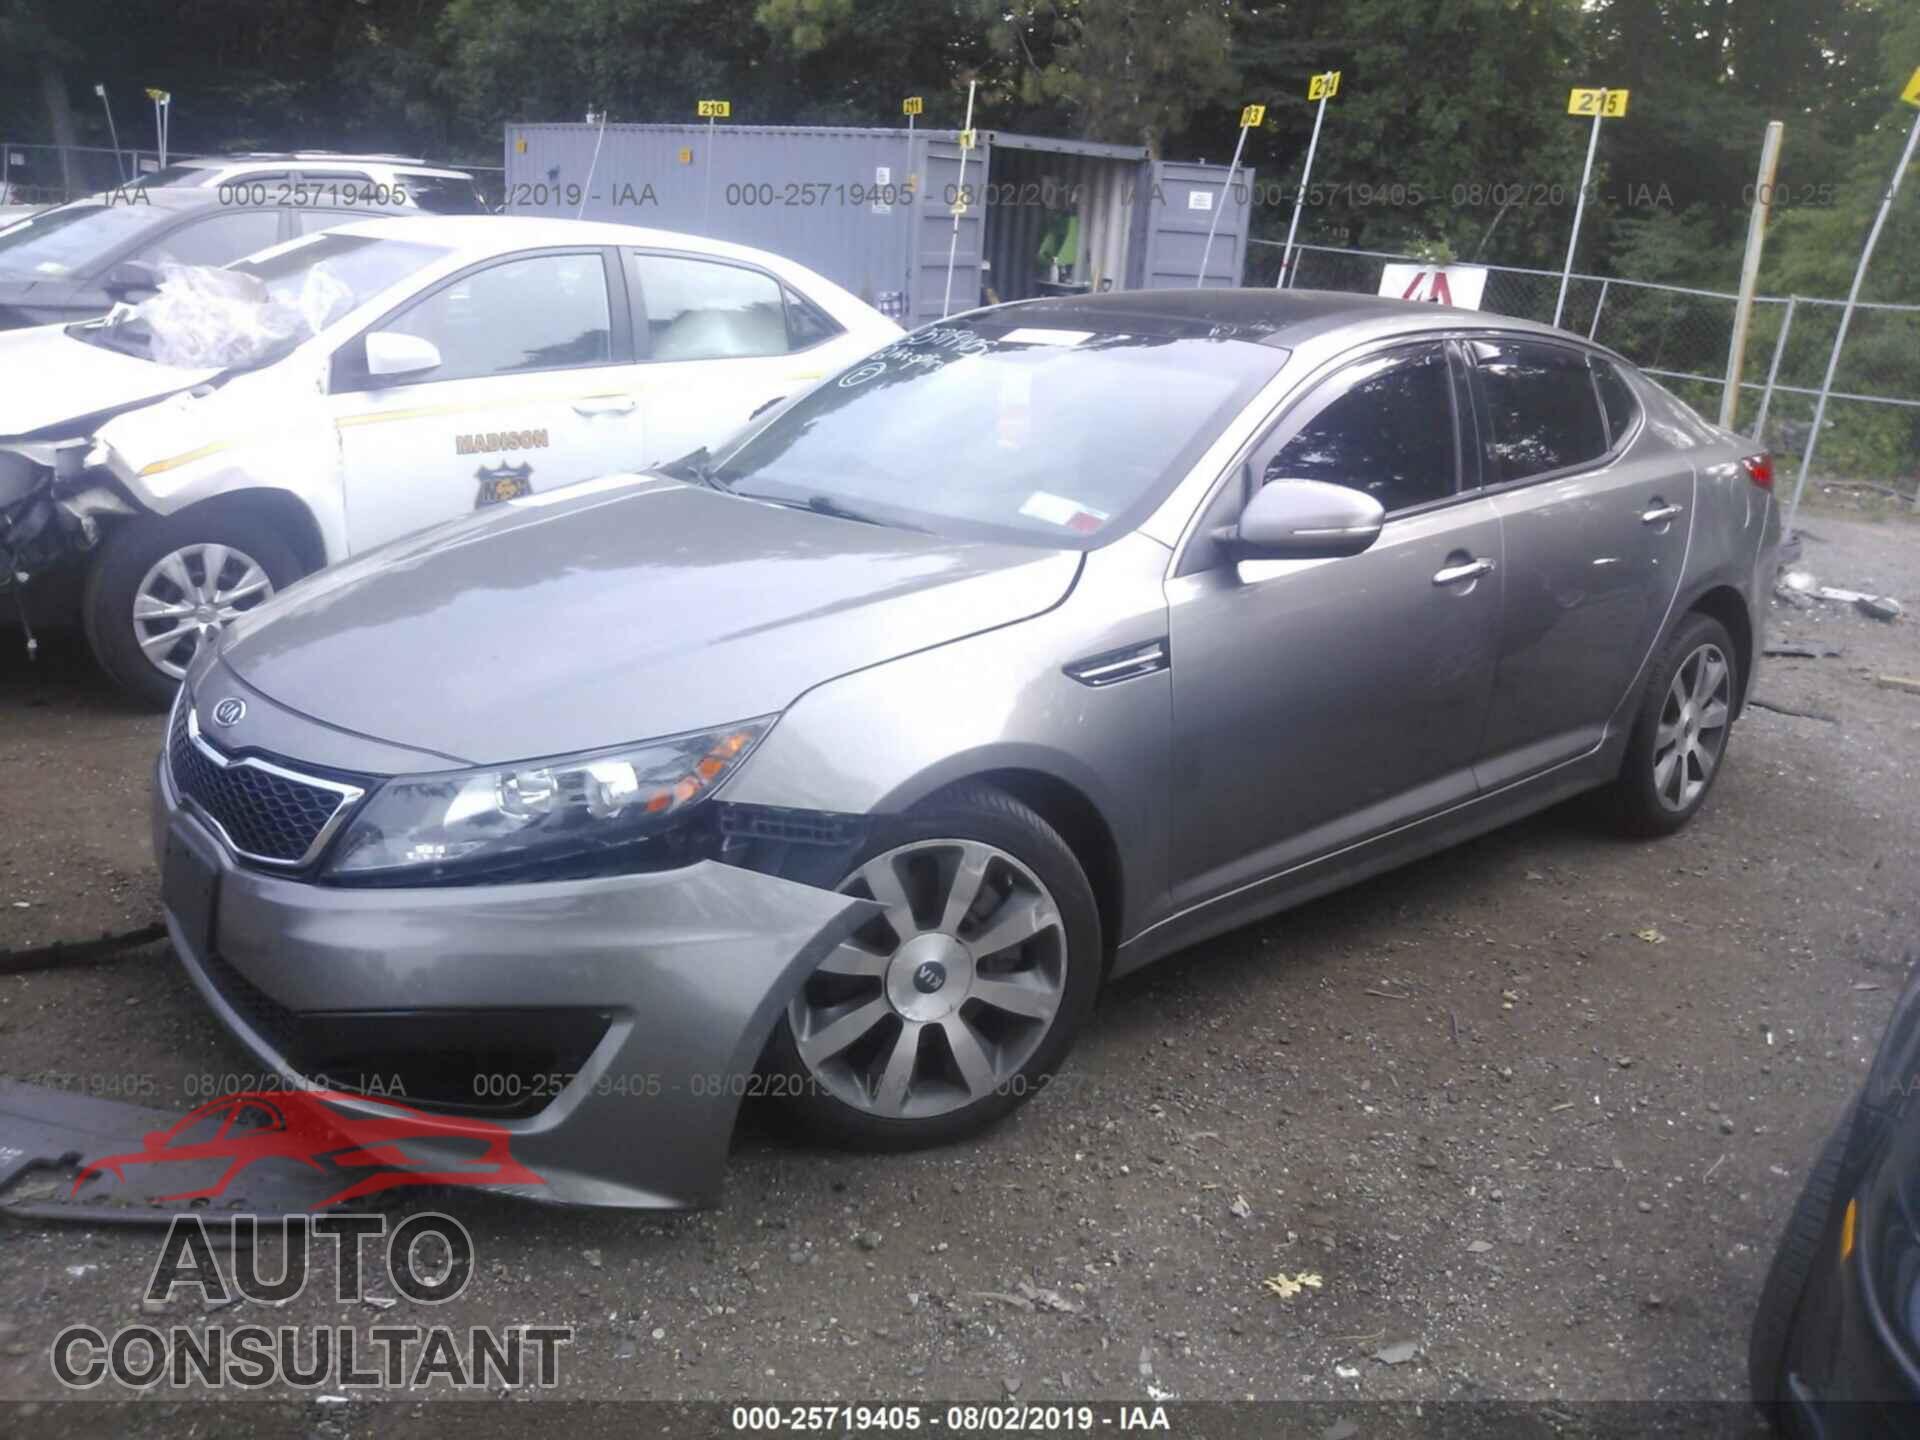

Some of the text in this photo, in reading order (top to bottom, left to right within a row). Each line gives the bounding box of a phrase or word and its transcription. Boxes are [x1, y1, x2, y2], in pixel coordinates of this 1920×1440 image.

[702, 103, 724, 115] 210
[1579, 92, 1617, 113] 215
[455, 428, 549, 455] MADISON
